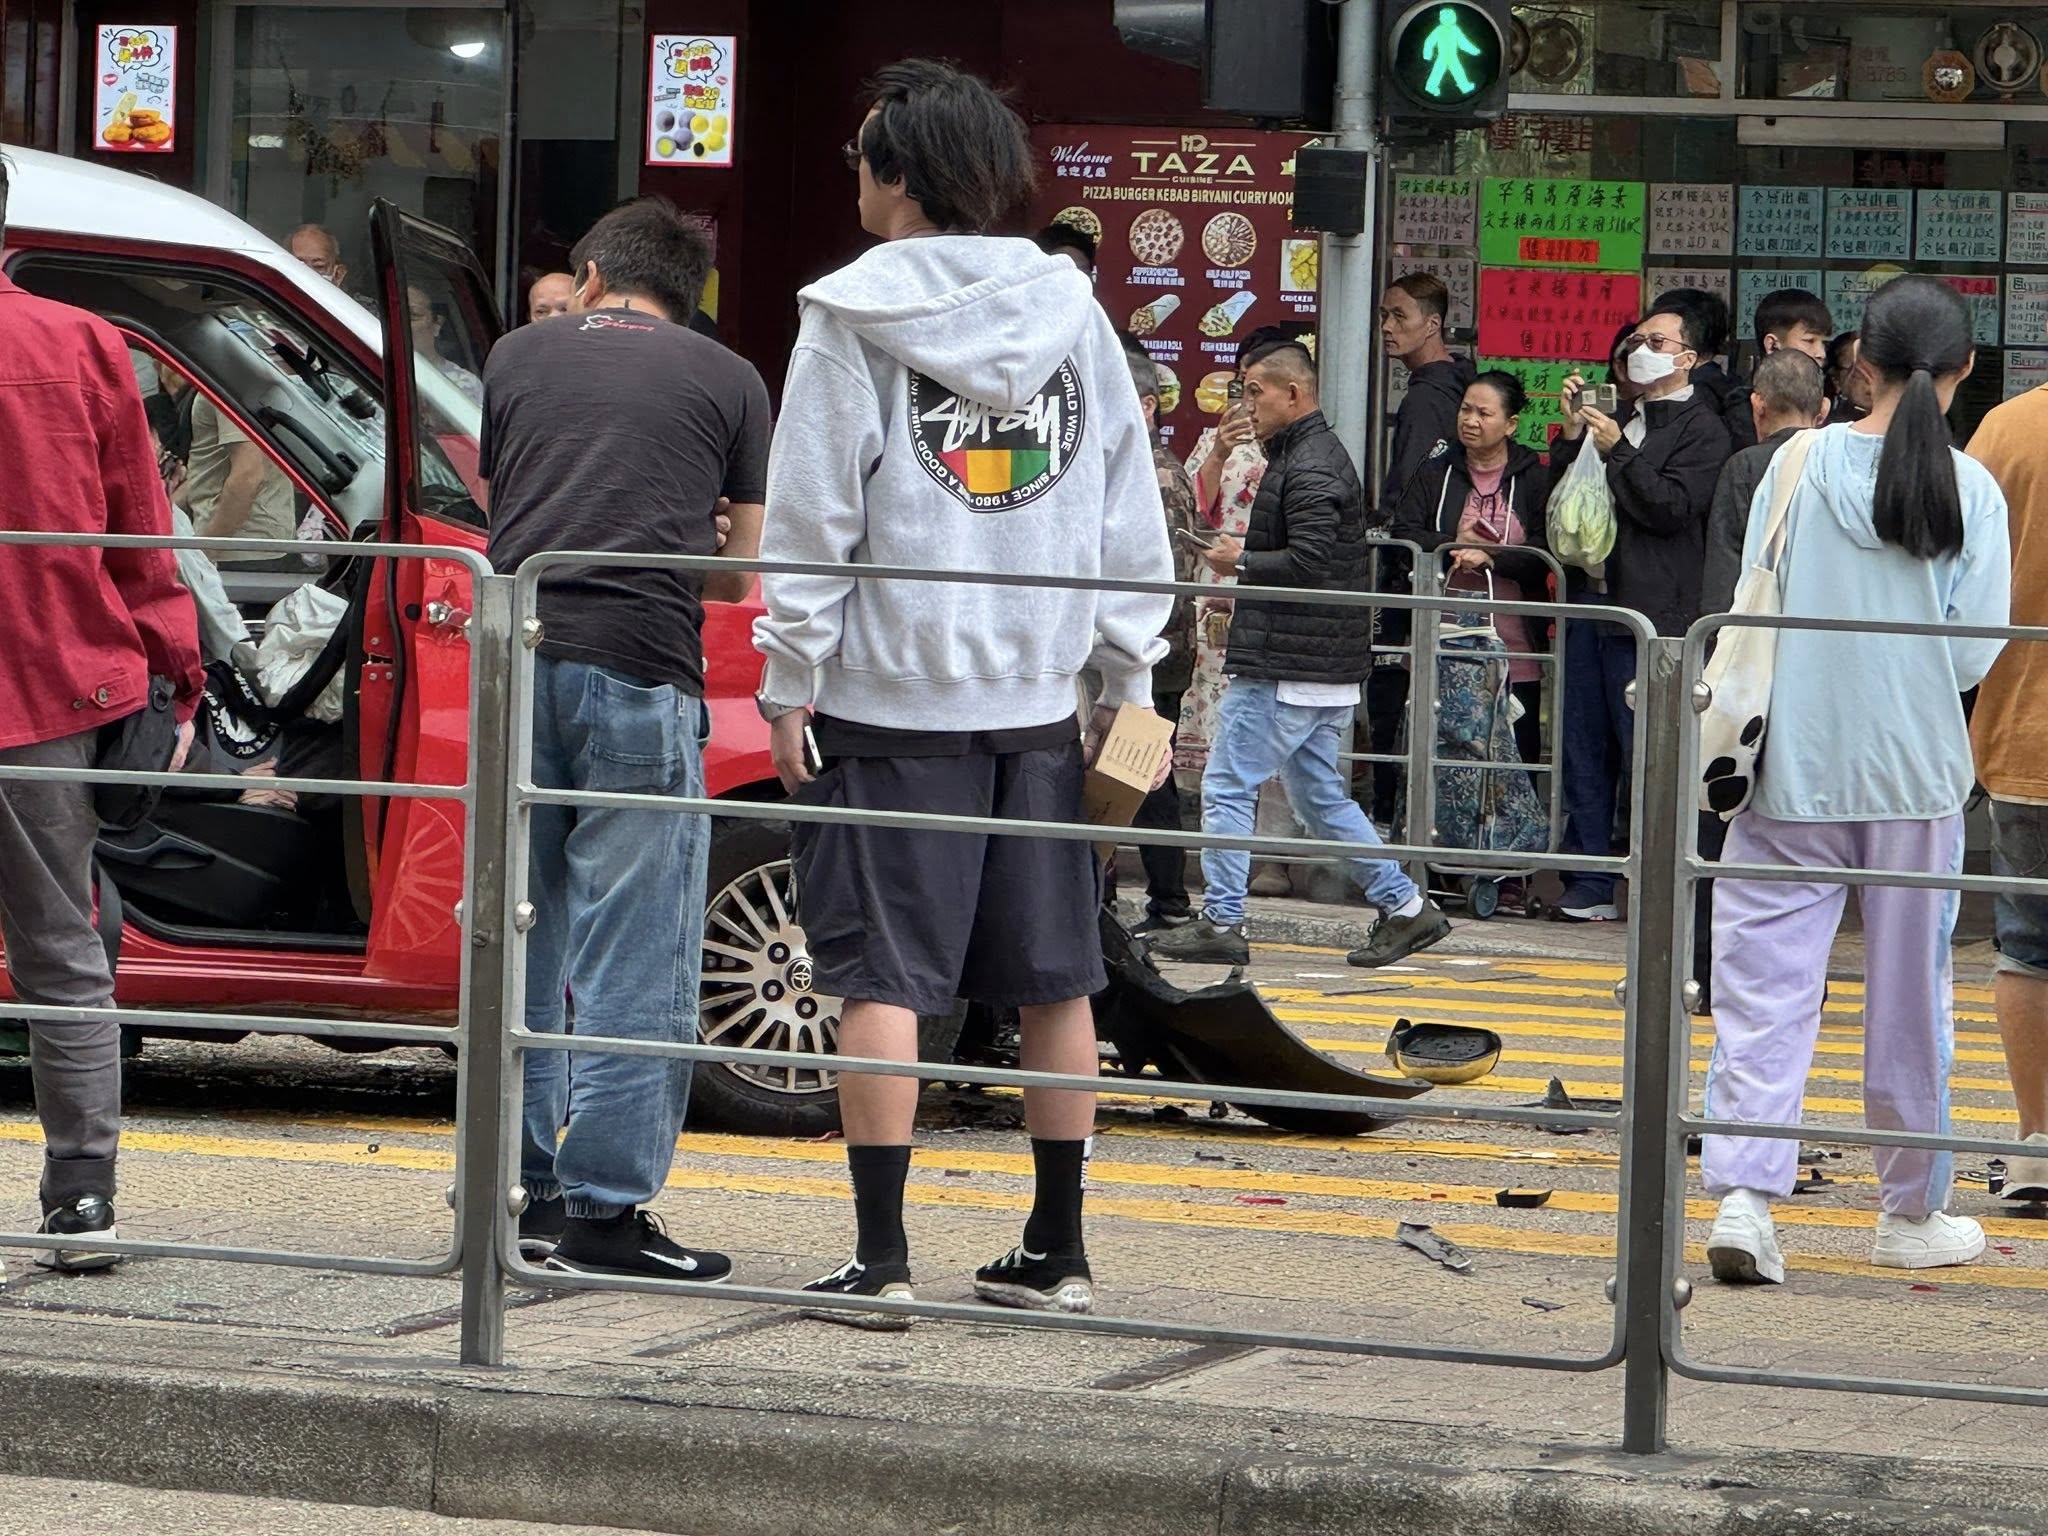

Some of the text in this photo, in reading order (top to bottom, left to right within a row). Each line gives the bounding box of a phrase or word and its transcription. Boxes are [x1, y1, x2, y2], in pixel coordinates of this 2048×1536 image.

[1050, 141, 1112, 164] Welcome
[1131, 152, 1255, 175] TAZA
[1082, 186, 1112, 199] PIZZA
[1113, 187, 1155, 200] BURGER
[1156, 188, 1190, 202] KEBAB
[1191, 189, 1232, 203] BIRYANI
[1233, 190, 1268, 204] CURRY
[911, 406, 923, 439] VIBE
[1061, 414, 1078, 452] WIDE
[917, 440, 948, 478] GOOD
[948, 475, 958, 486] A
[975, 472, 1050, 507] SINCE 1980
